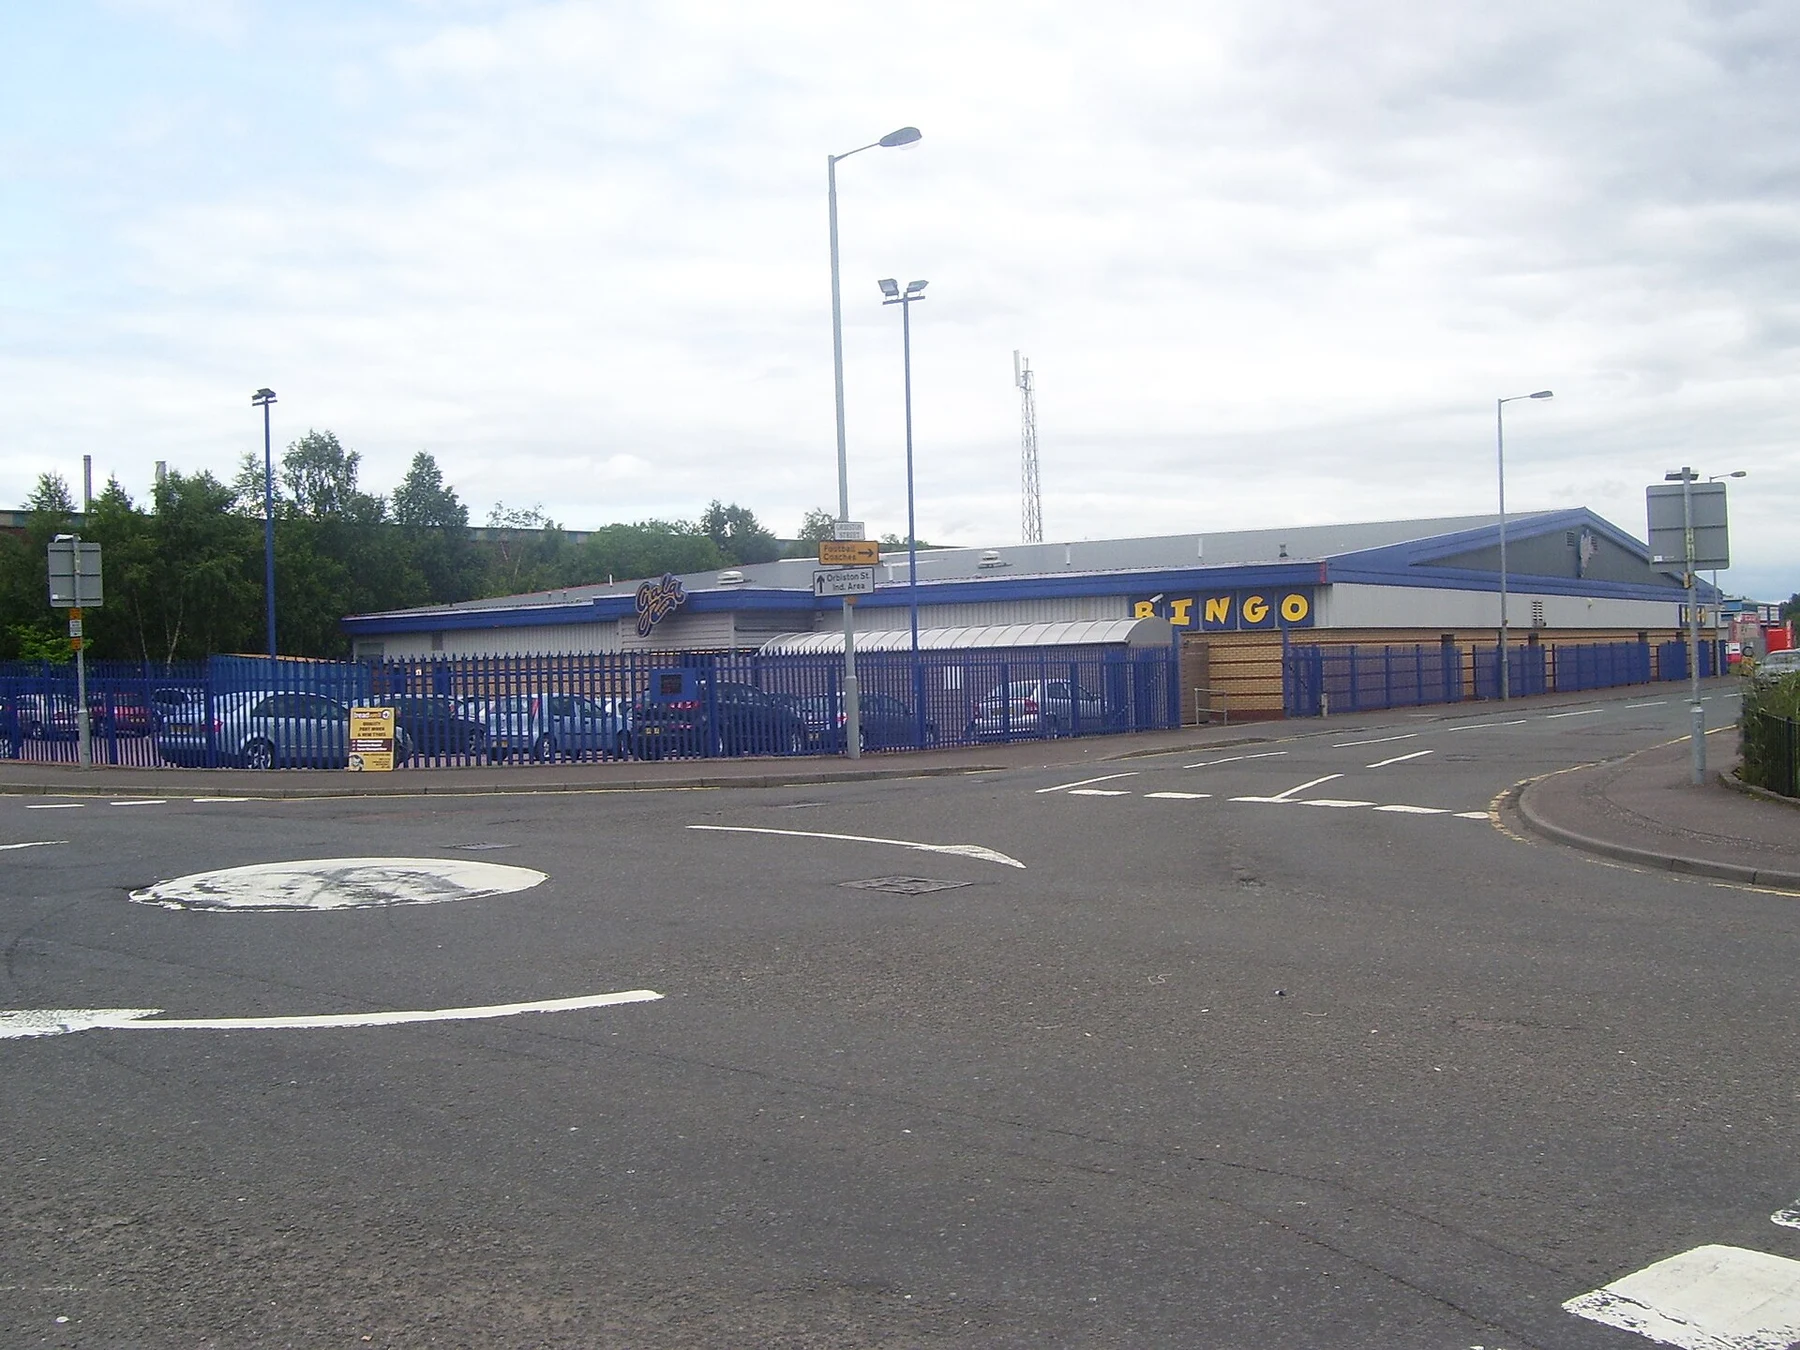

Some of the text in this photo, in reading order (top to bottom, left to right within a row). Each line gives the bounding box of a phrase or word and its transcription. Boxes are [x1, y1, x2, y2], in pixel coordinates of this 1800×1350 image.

[827, 572, 859, 582] Orbiston
[847, 582, 865, 590] Area
[636, 572, 686, 638] Gala
[1134, 593, 1309, 626] BINGO
